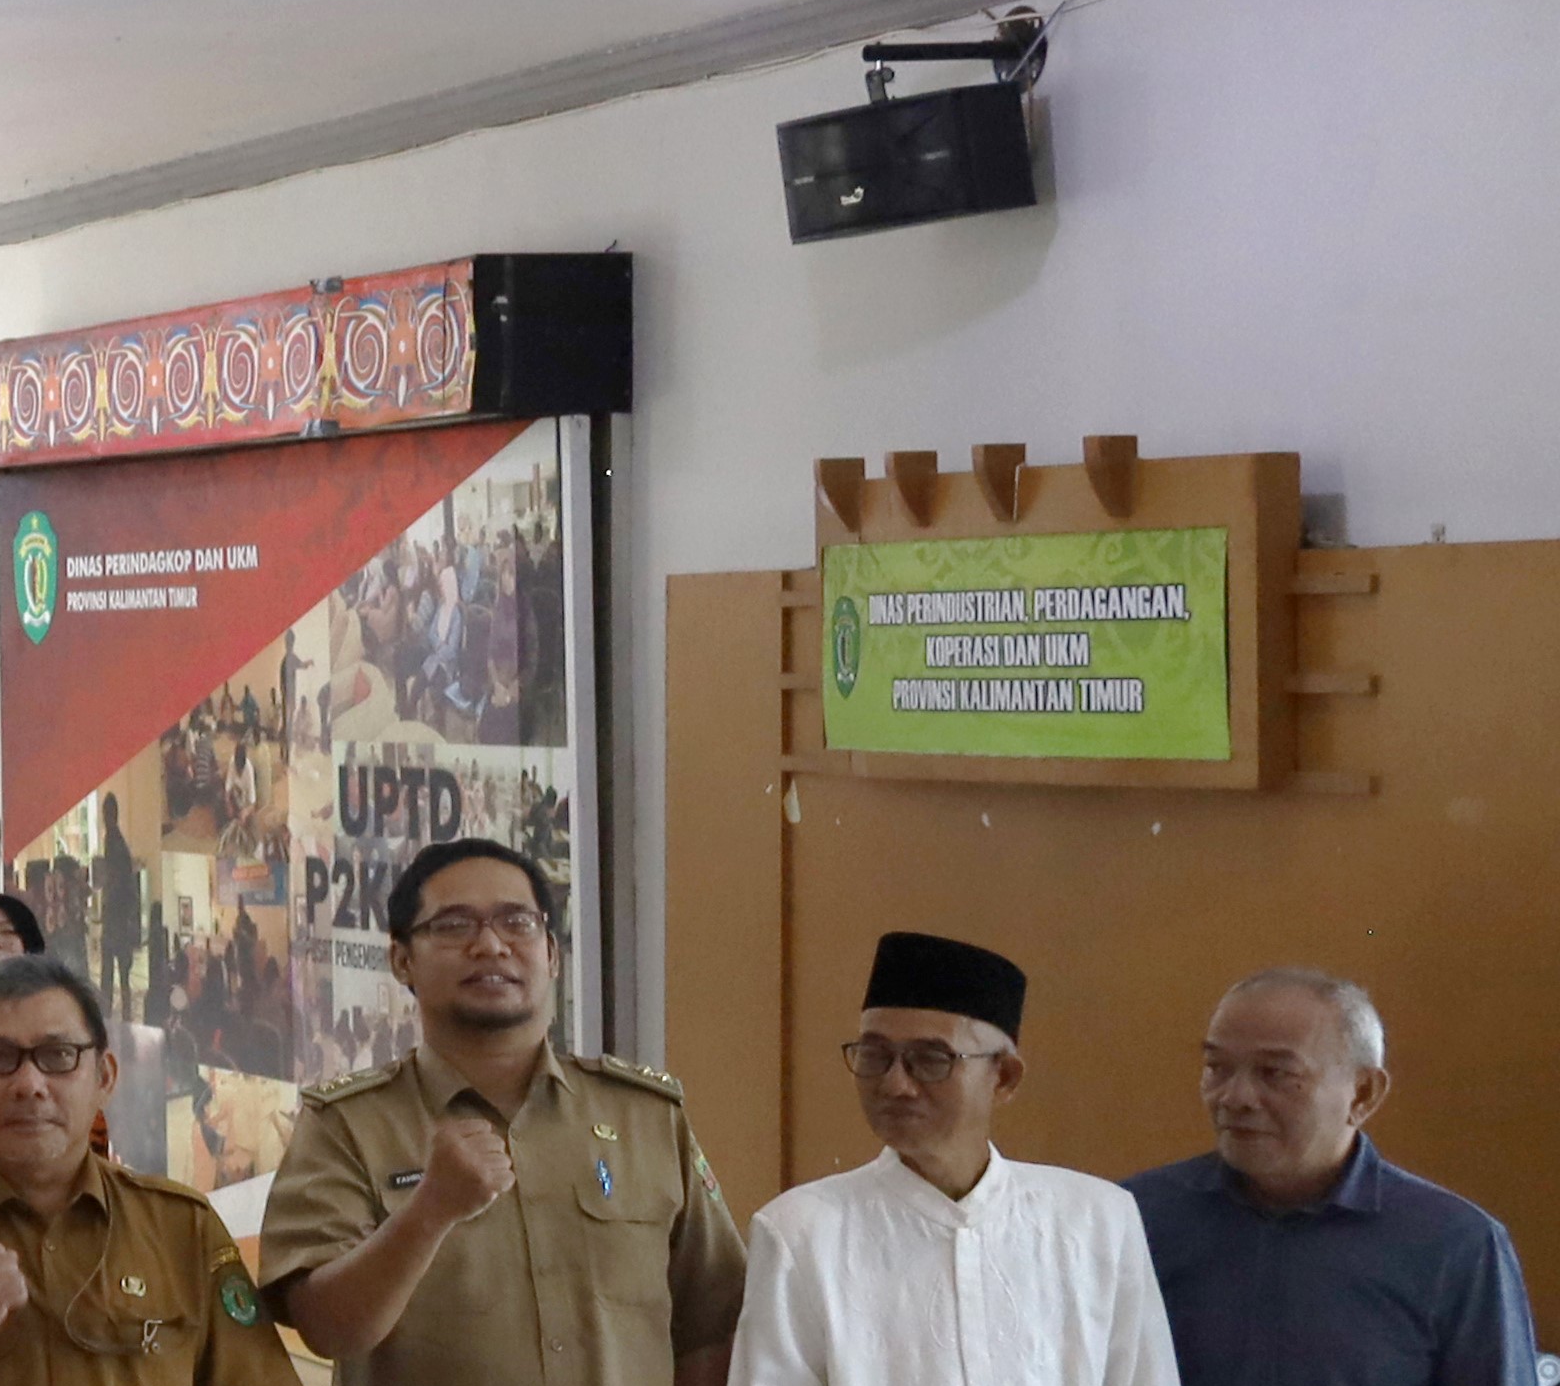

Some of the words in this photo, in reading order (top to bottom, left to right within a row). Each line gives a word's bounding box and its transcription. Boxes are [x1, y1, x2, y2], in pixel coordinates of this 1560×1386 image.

[66, 554, 104, 578] DINAS
[105, 549, 193, 577] PERINDAGKOP
[195, 547, 224, 572] DAN
[226, 544, 259, 569] UKM
[66, 590, 108, 612] PROVINSI
[109, 588, 168, 611] KALIMANTAN
[168, 586, 199, 608] TIMUR
[868, 593, 904, 625] DINAS
[906, 589, 1029, 624] PERINDUSTRIAN,
[1033, 584, 1191, 622] PERDAGANGAN,
[925, 634, 1000, 668] KOPERASI
[1002, 633, 1041, 667] DAN
[1044, 632, 1090, 666] UKM
[892, 678, 956, 711] PROVINSI
[958, 678, 1074, 712] KALIMANTAN
[1077, 678, 1145, 712] TIMUR
[338, 764, 462, 842] UPTD
